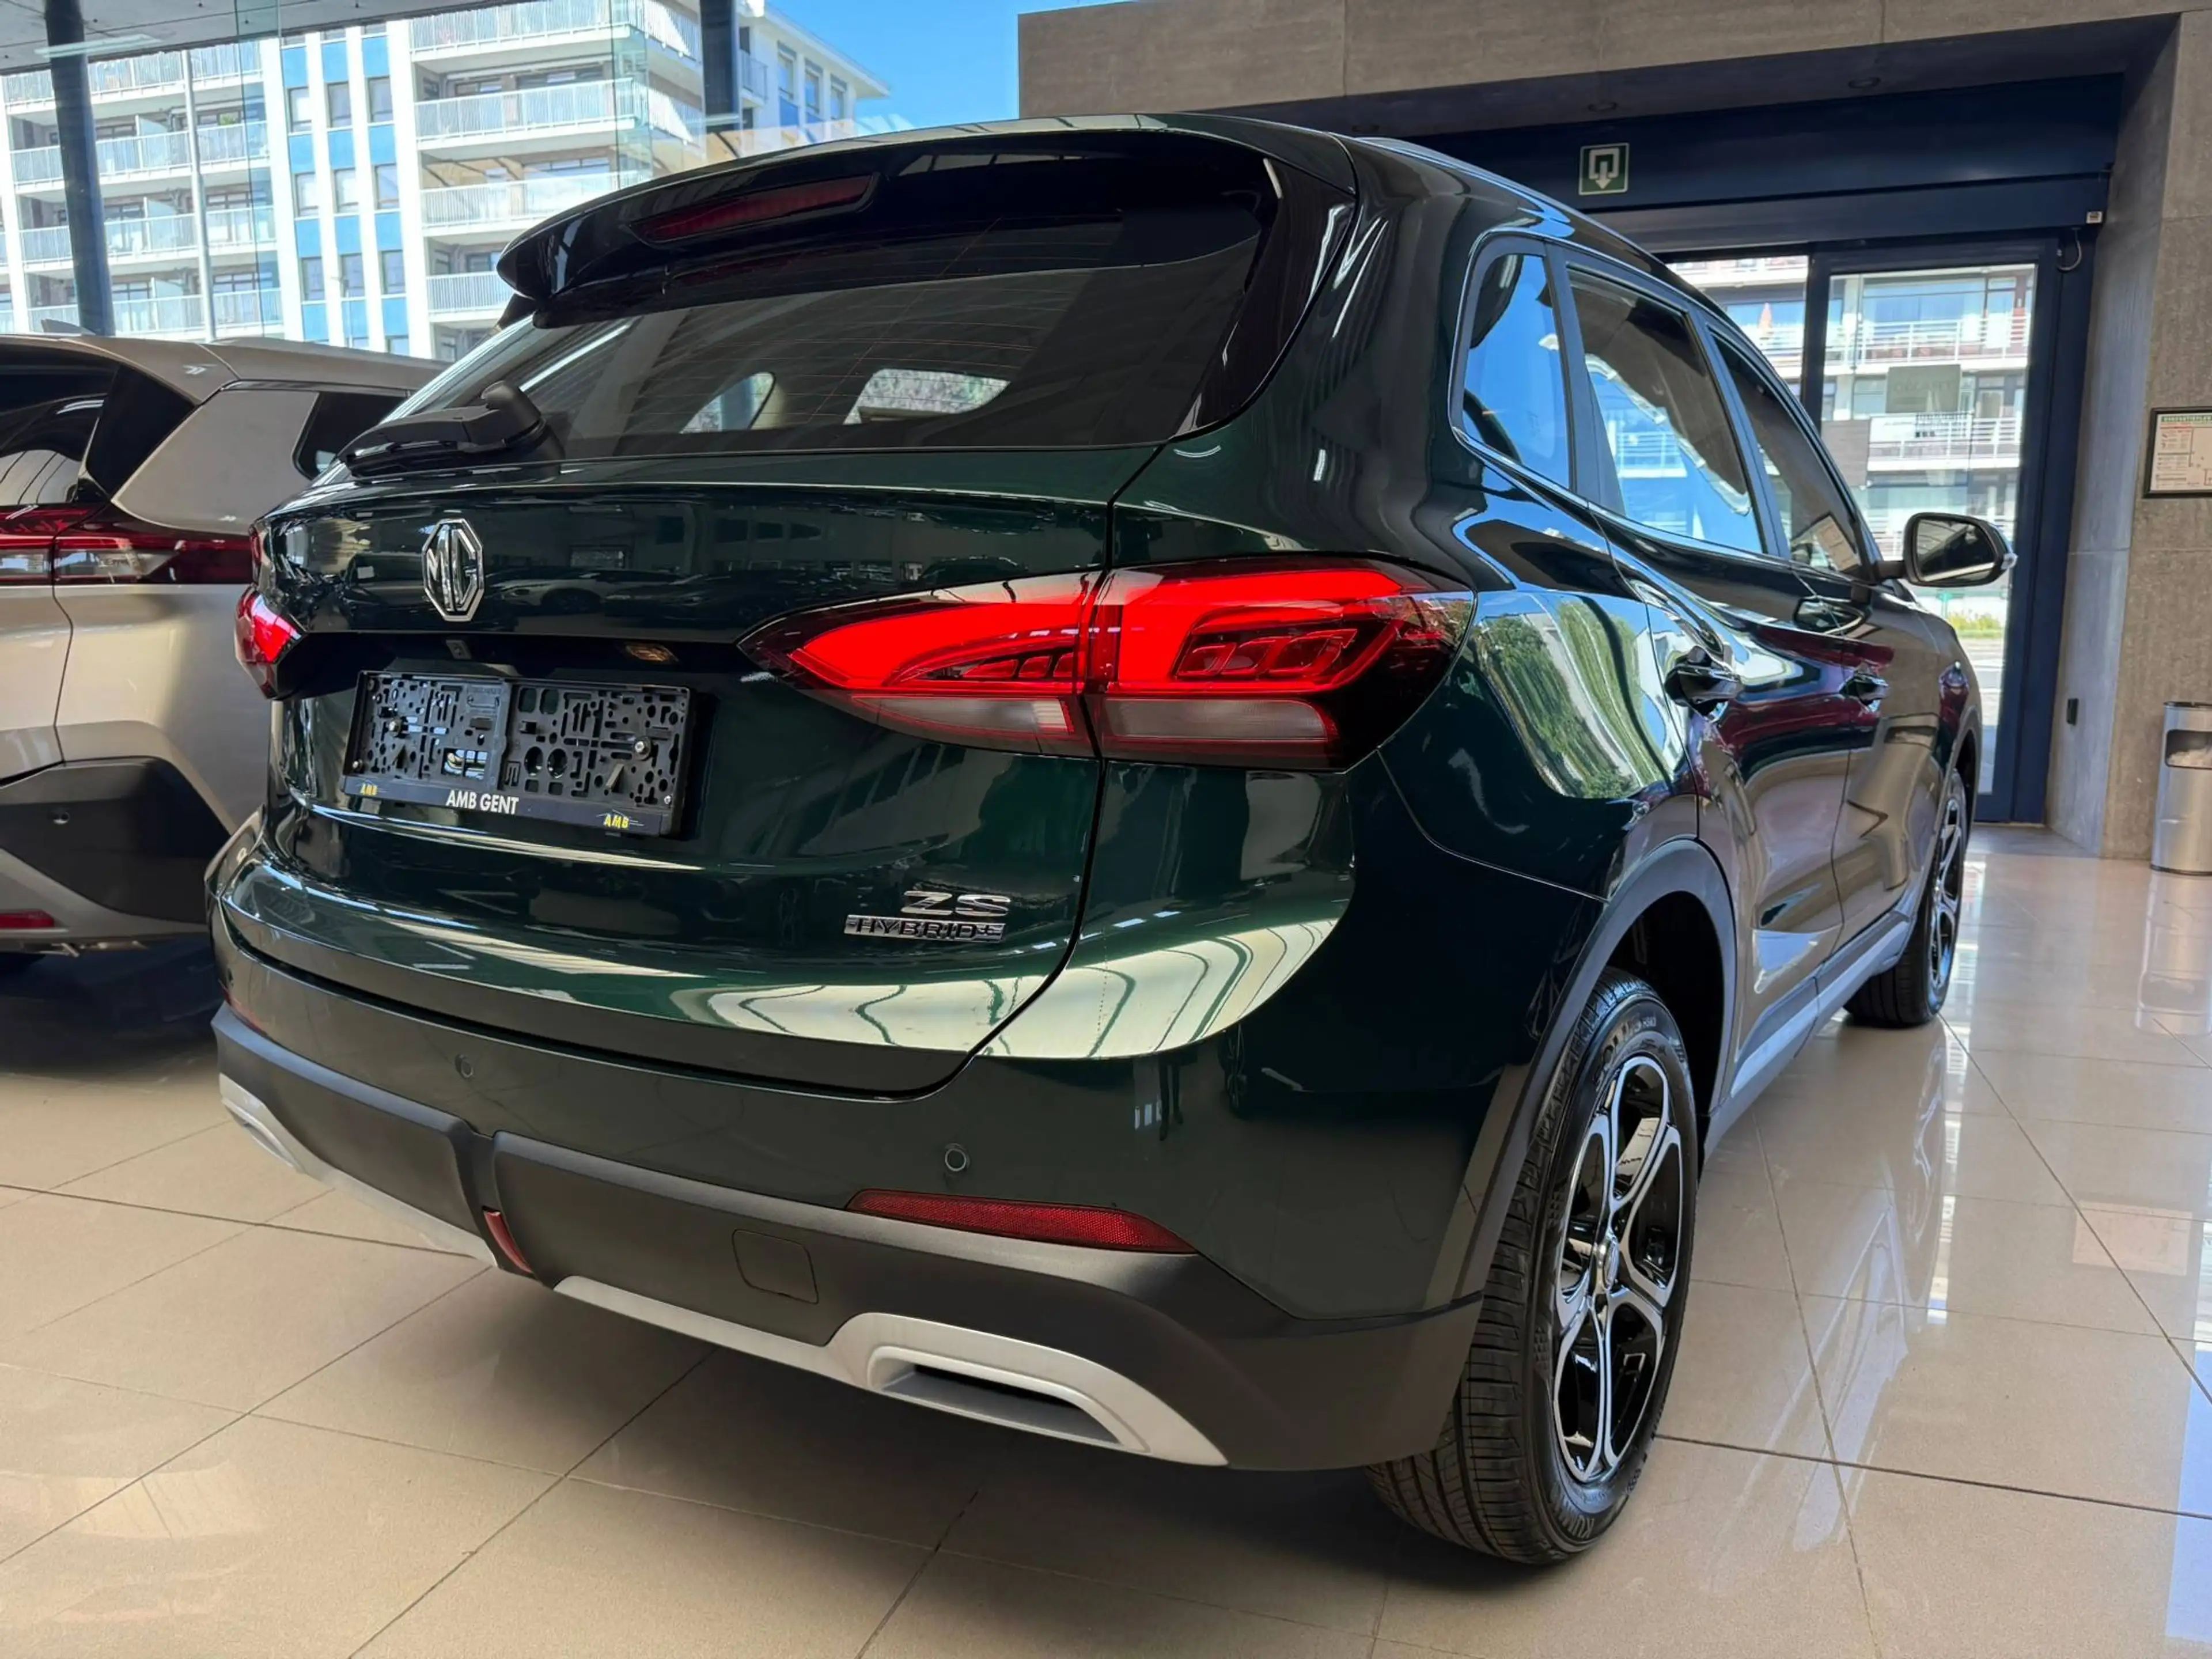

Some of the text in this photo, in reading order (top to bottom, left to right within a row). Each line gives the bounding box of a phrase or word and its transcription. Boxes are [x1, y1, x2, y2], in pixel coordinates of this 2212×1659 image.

[426, 524, 478, 612] MG
[445, 789, 519, 815] AMB GENT
[603, 813, 630, 829] AMB
[901, 891, 1011, 917] ZS
